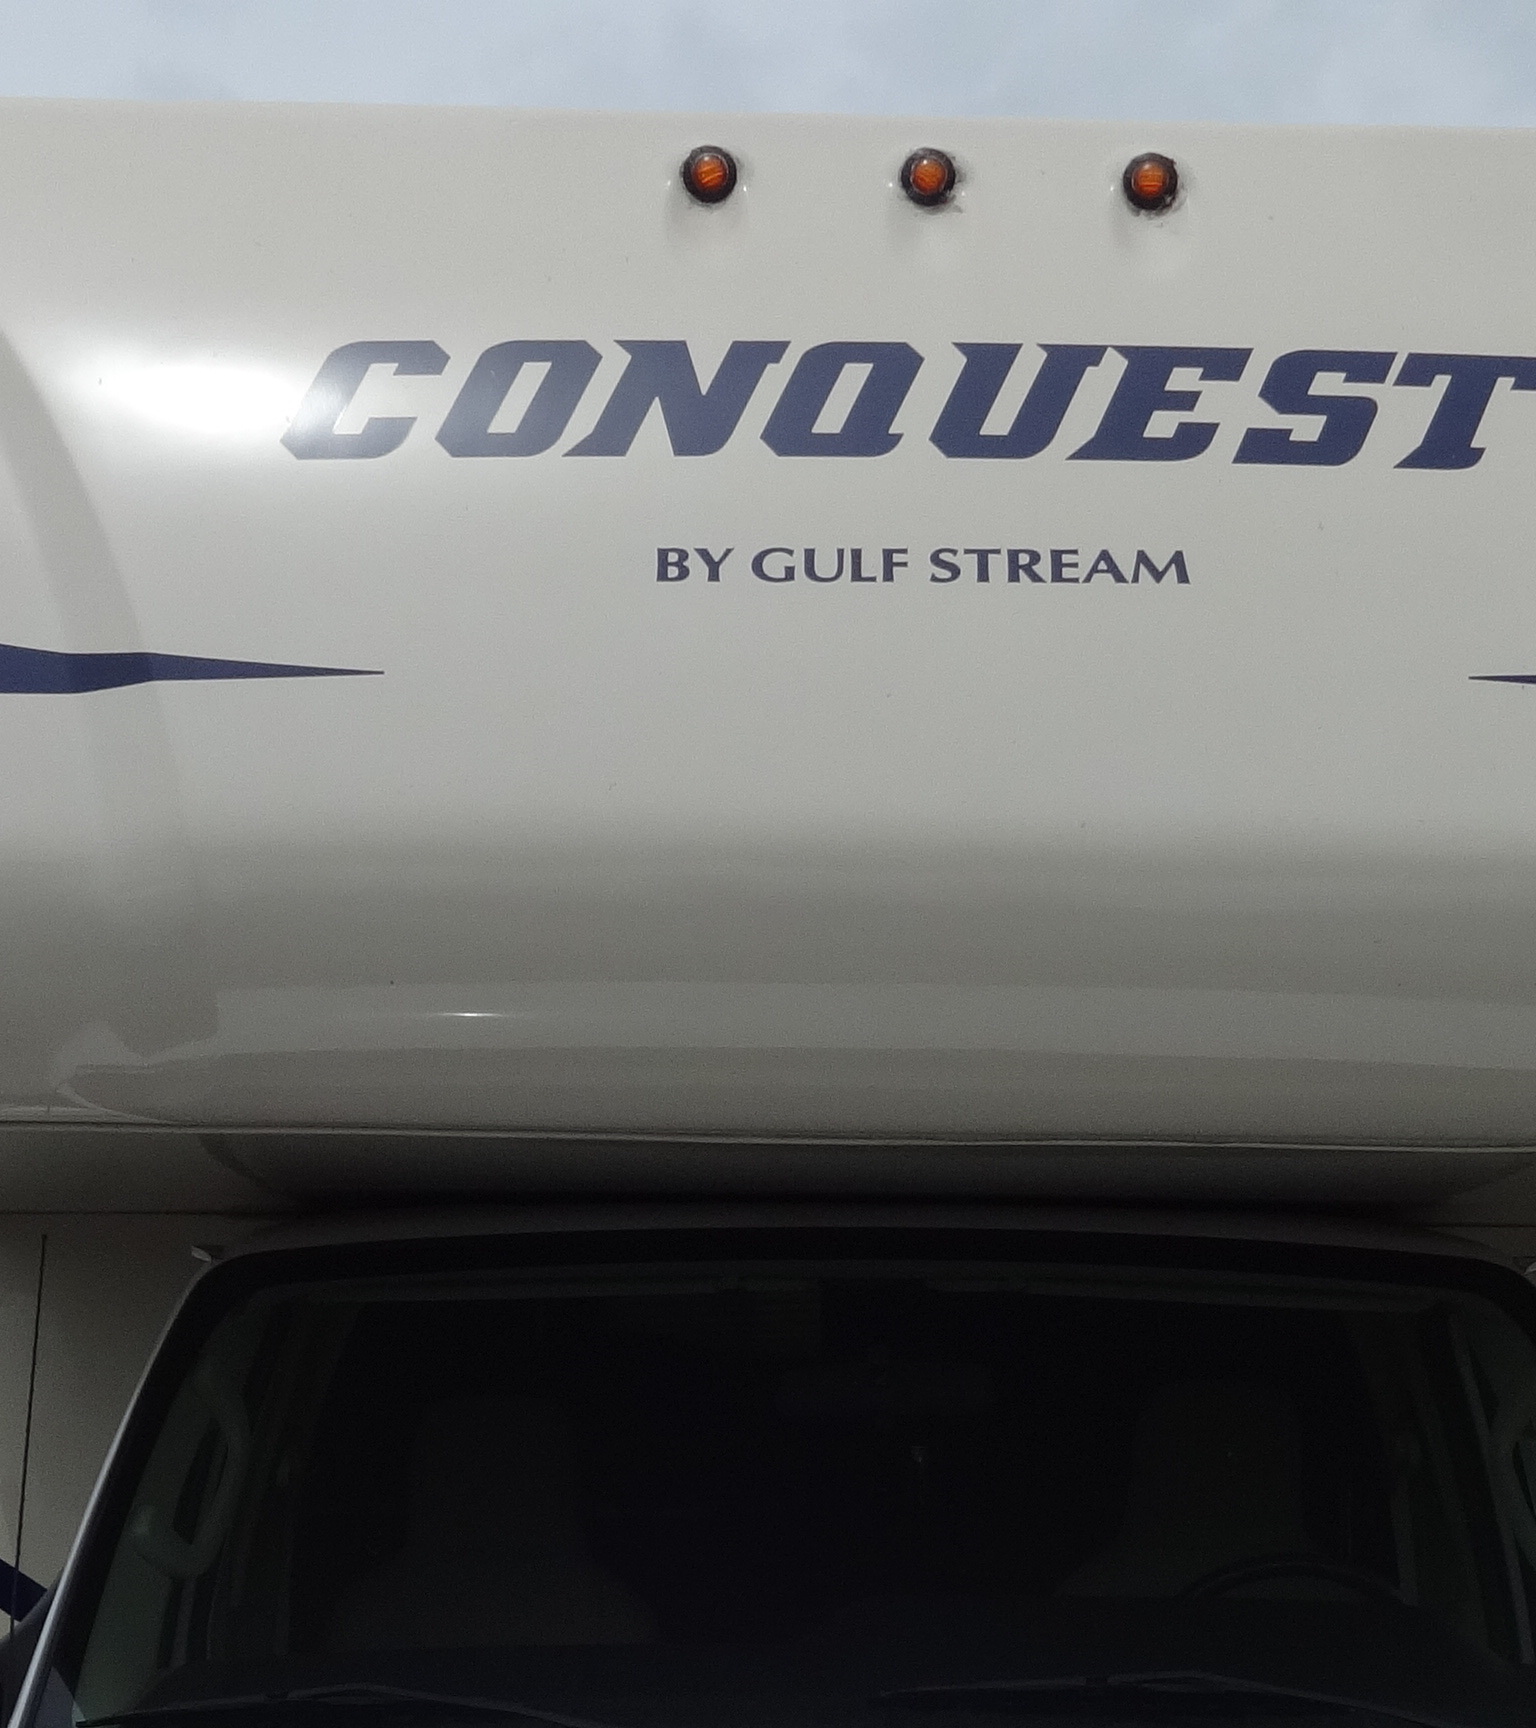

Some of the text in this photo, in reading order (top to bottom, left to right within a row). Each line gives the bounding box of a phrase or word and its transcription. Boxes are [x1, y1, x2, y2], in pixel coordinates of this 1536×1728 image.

[656, 546, 1191, 585] BY GULF STREAM
